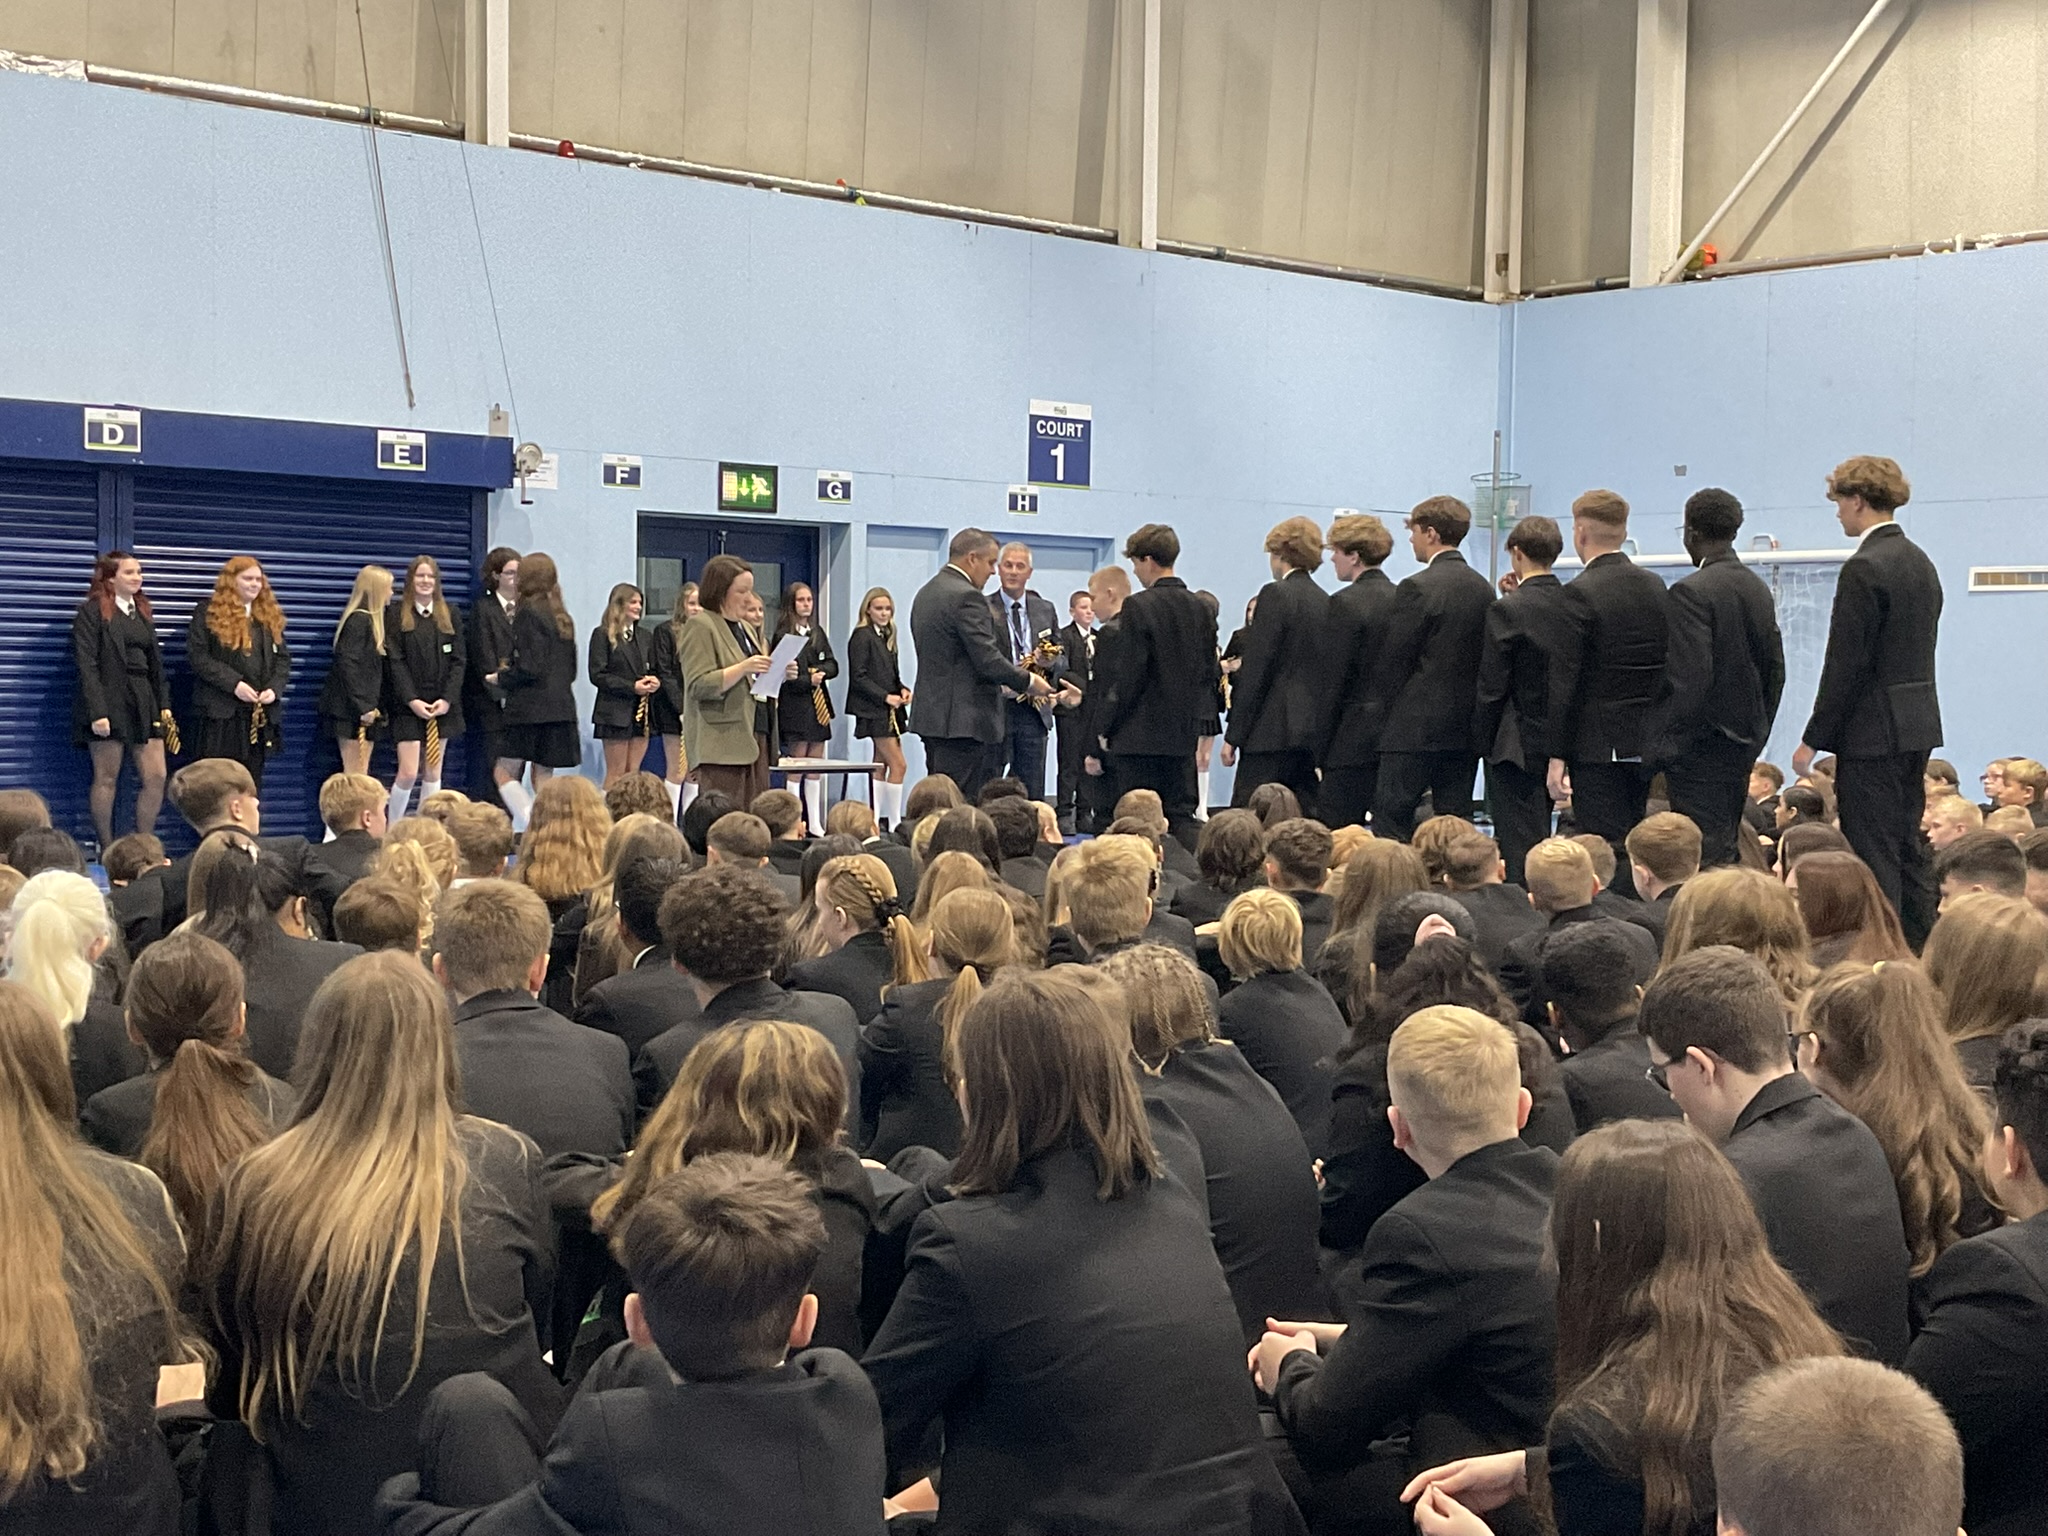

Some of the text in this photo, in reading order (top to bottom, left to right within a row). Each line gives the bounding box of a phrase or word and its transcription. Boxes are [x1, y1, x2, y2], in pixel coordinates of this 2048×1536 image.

[103, 423, 124, 445] D
[1036, 420, 1084, 437] COURT
[394, 444, 410, 464] E
[1050, 443, 1064, 481] 1
[616, 466, 630, 484] F
[827, 481, 843, 499] G
[1017, 495, 1030, 511] H
